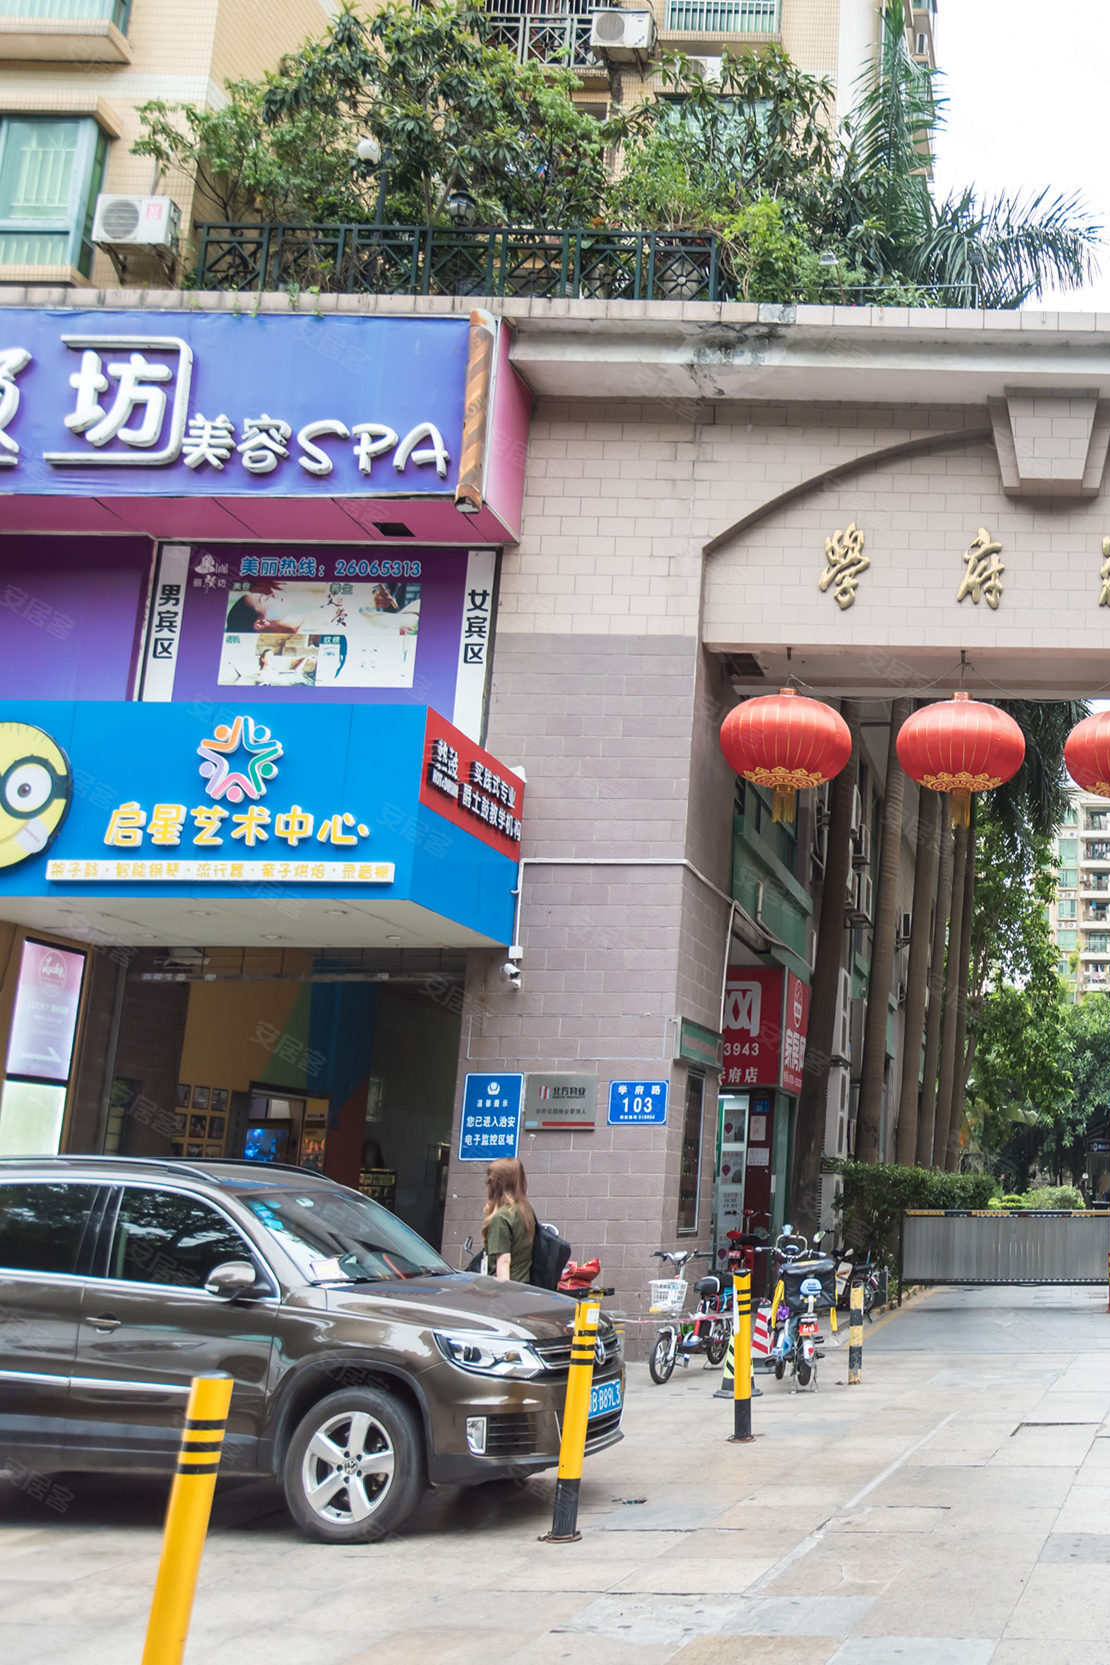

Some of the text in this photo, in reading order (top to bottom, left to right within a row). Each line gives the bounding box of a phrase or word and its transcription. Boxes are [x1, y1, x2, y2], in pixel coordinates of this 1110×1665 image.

[152, 584, 182, 659] 男宾区
[463, 590, 490, 664] 女宾区
[474, 760, 516, 809] 实践式专业
[104, 801, 370, 847] 启星艺术中心
[462, 783, 522, 842] 爵士鼓教学机构
[552, 1086, 586, 1096] 北方物业
[618, 1085, 661, 1095] 学府路
[622, 1097, 653, 1113] 103
[466, 1116, 516, 1128] 您已进入治安
[464, 1134, 514, 1146] 电子监控区域
